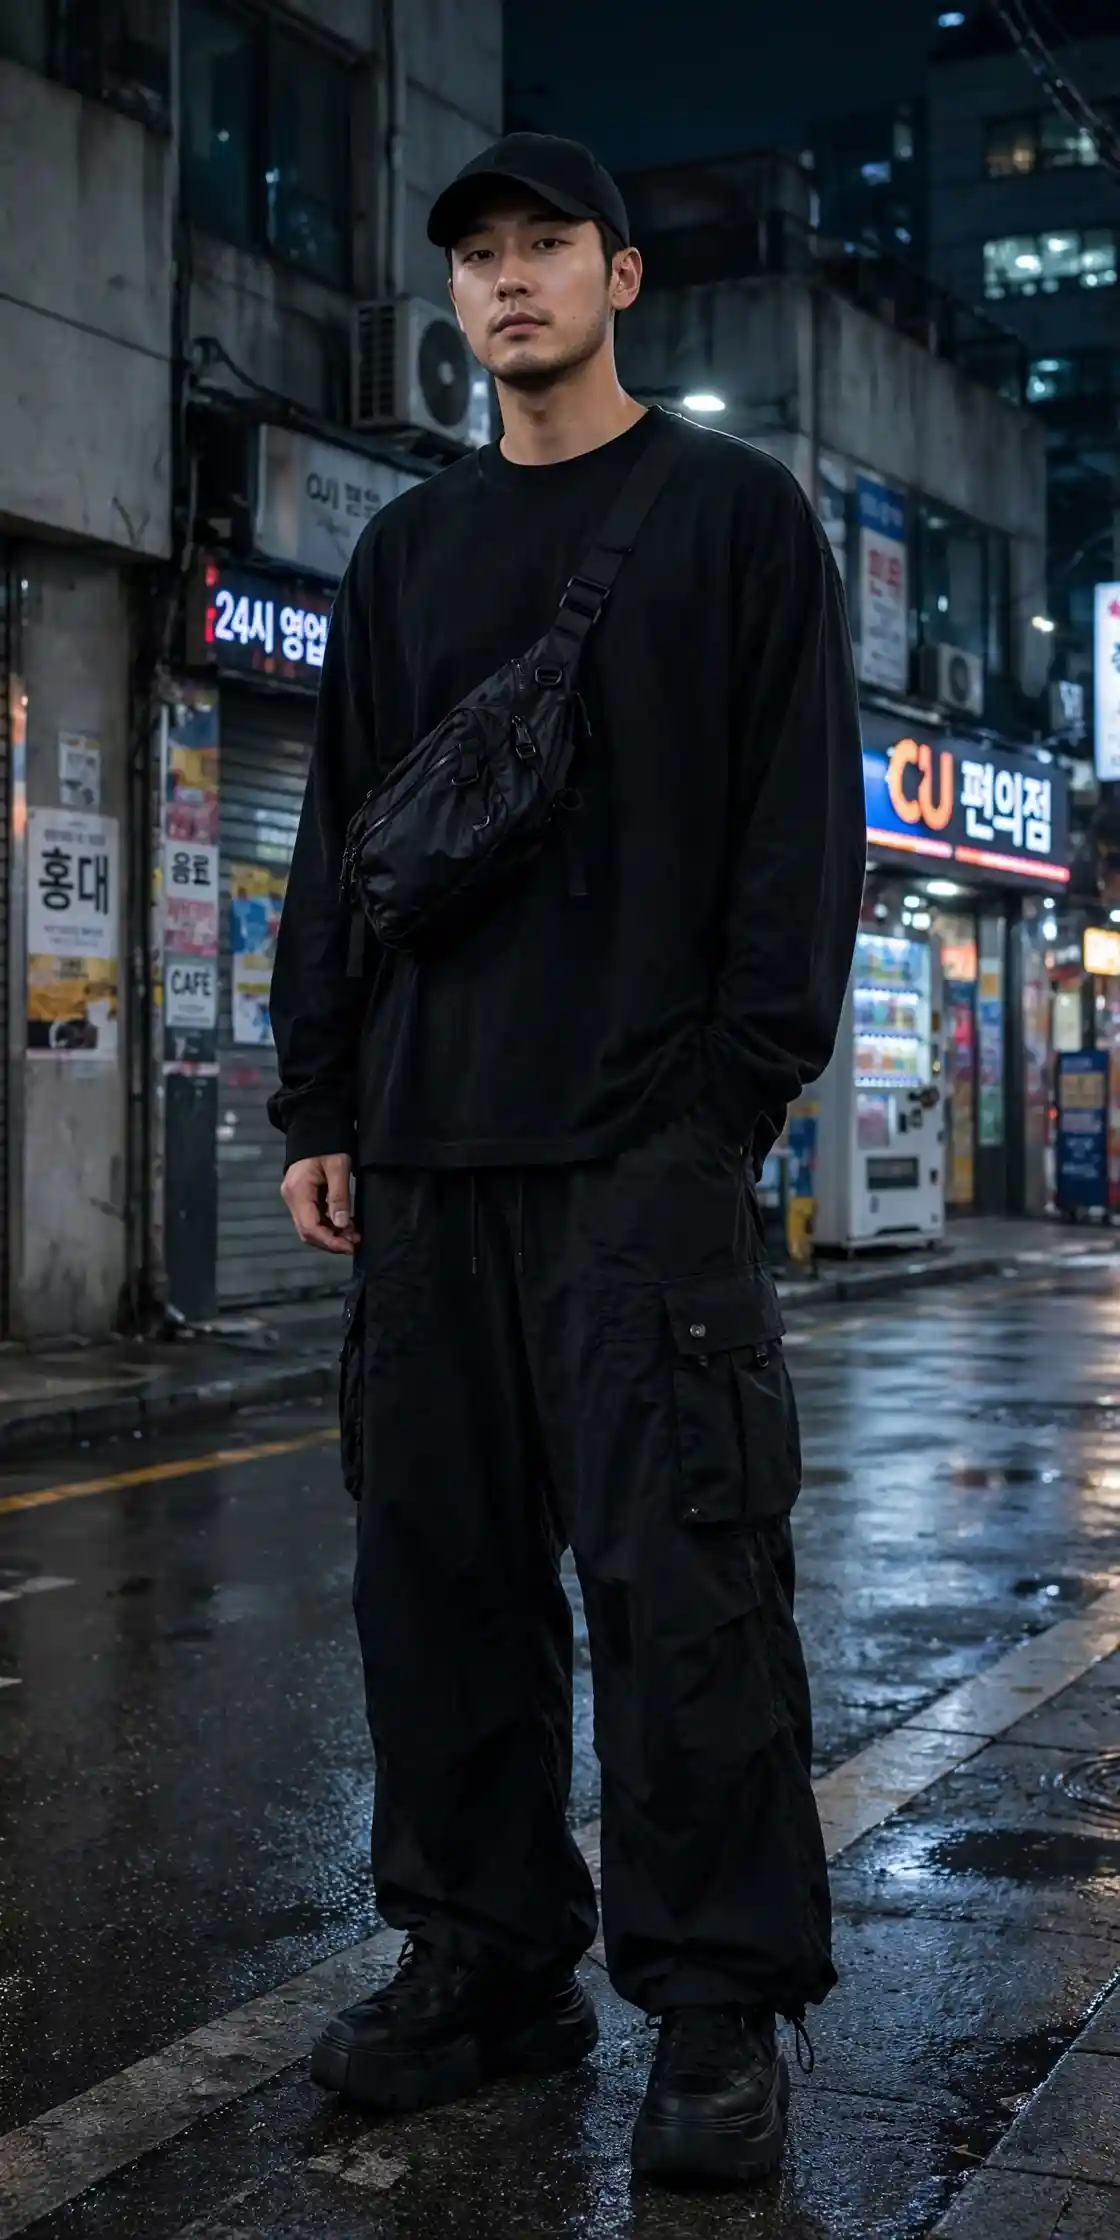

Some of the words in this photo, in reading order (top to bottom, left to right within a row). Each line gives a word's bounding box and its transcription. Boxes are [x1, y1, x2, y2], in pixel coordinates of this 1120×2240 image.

[215, 590, 274, 654] 24시
[280, 606, 328, 667] 영업
[888, 738, 954, 830] CU
[961, 760, 1051, 854] 편의점
[39, 846, 109, 915] 홍대
